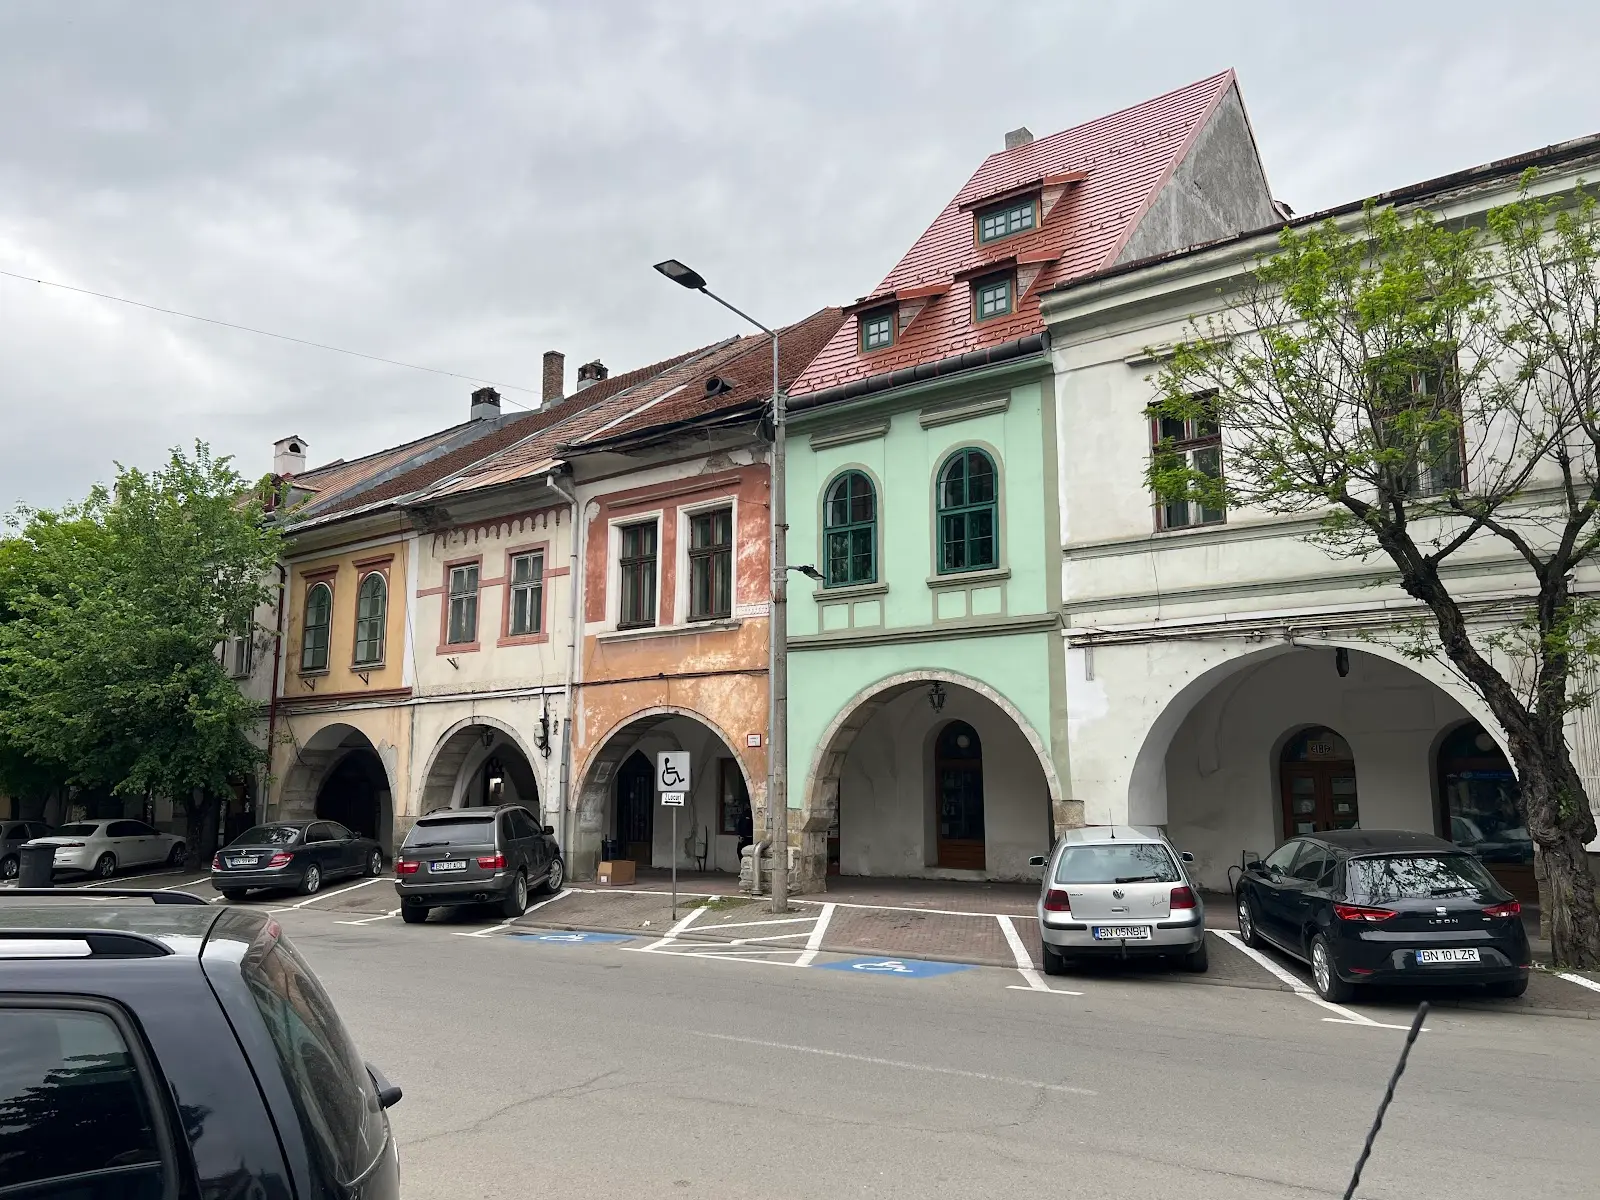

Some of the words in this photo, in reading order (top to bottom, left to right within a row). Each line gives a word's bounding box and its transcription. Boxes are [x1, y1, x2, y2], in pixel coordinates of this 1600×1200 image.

[436, 862, 445, 870] BN
[1100, 928, 1113, 937] BN
[1422, 950, 1439, 961] BN
[1442, 950, 1452, 960] 10
[1454, 949, 1476, 960] LZR
